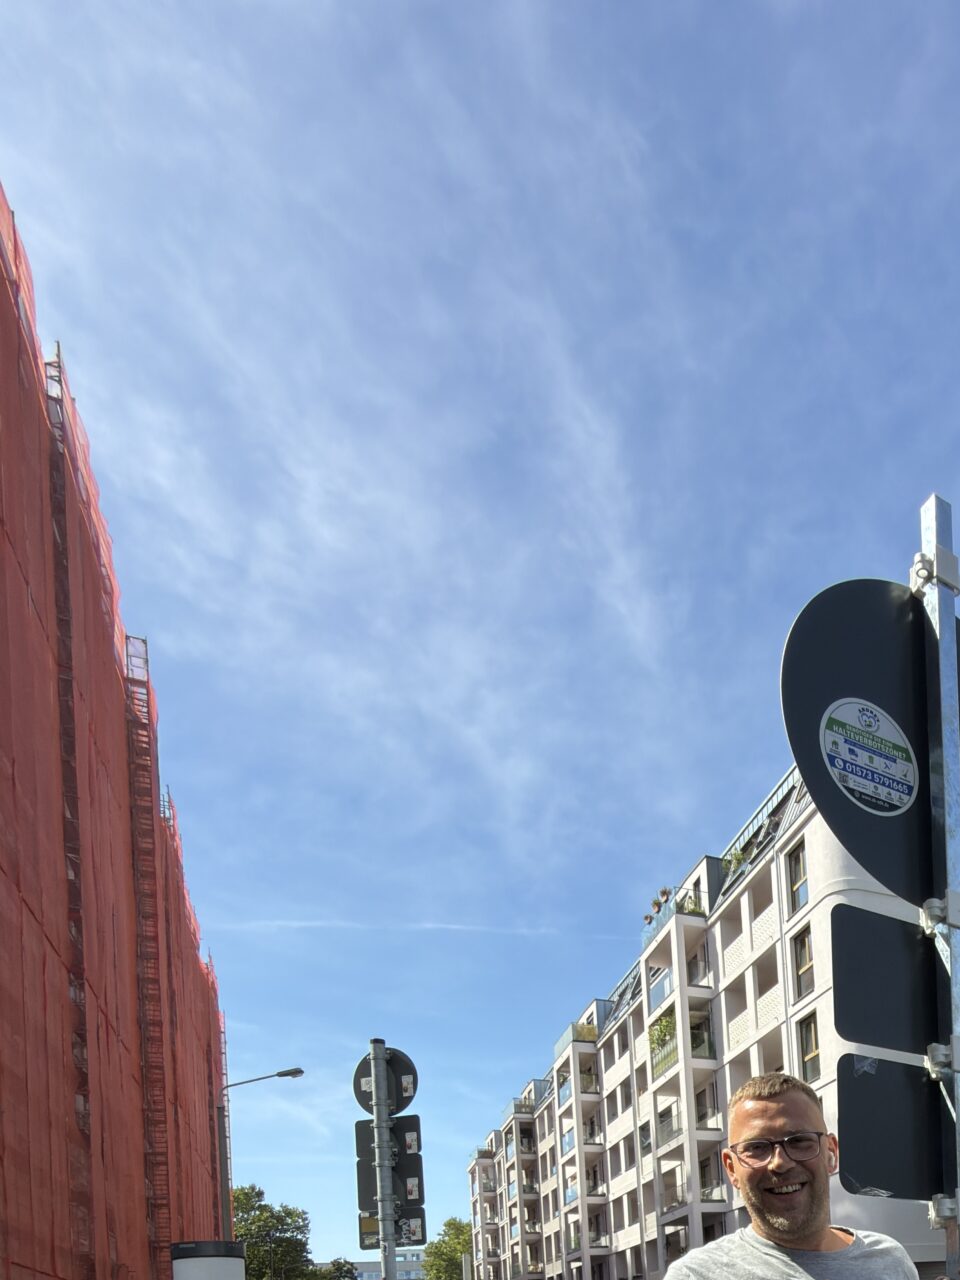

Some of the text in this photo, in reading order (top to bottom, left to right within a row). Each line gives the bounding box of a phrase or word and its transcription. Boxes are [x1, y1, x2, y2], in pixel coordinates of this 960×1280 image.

[833, 725, 906, 759] HALTEVERBOTSZONE?
[845, 762, 872, 780] 01573
[873, 772, 909, 794] 5791665
